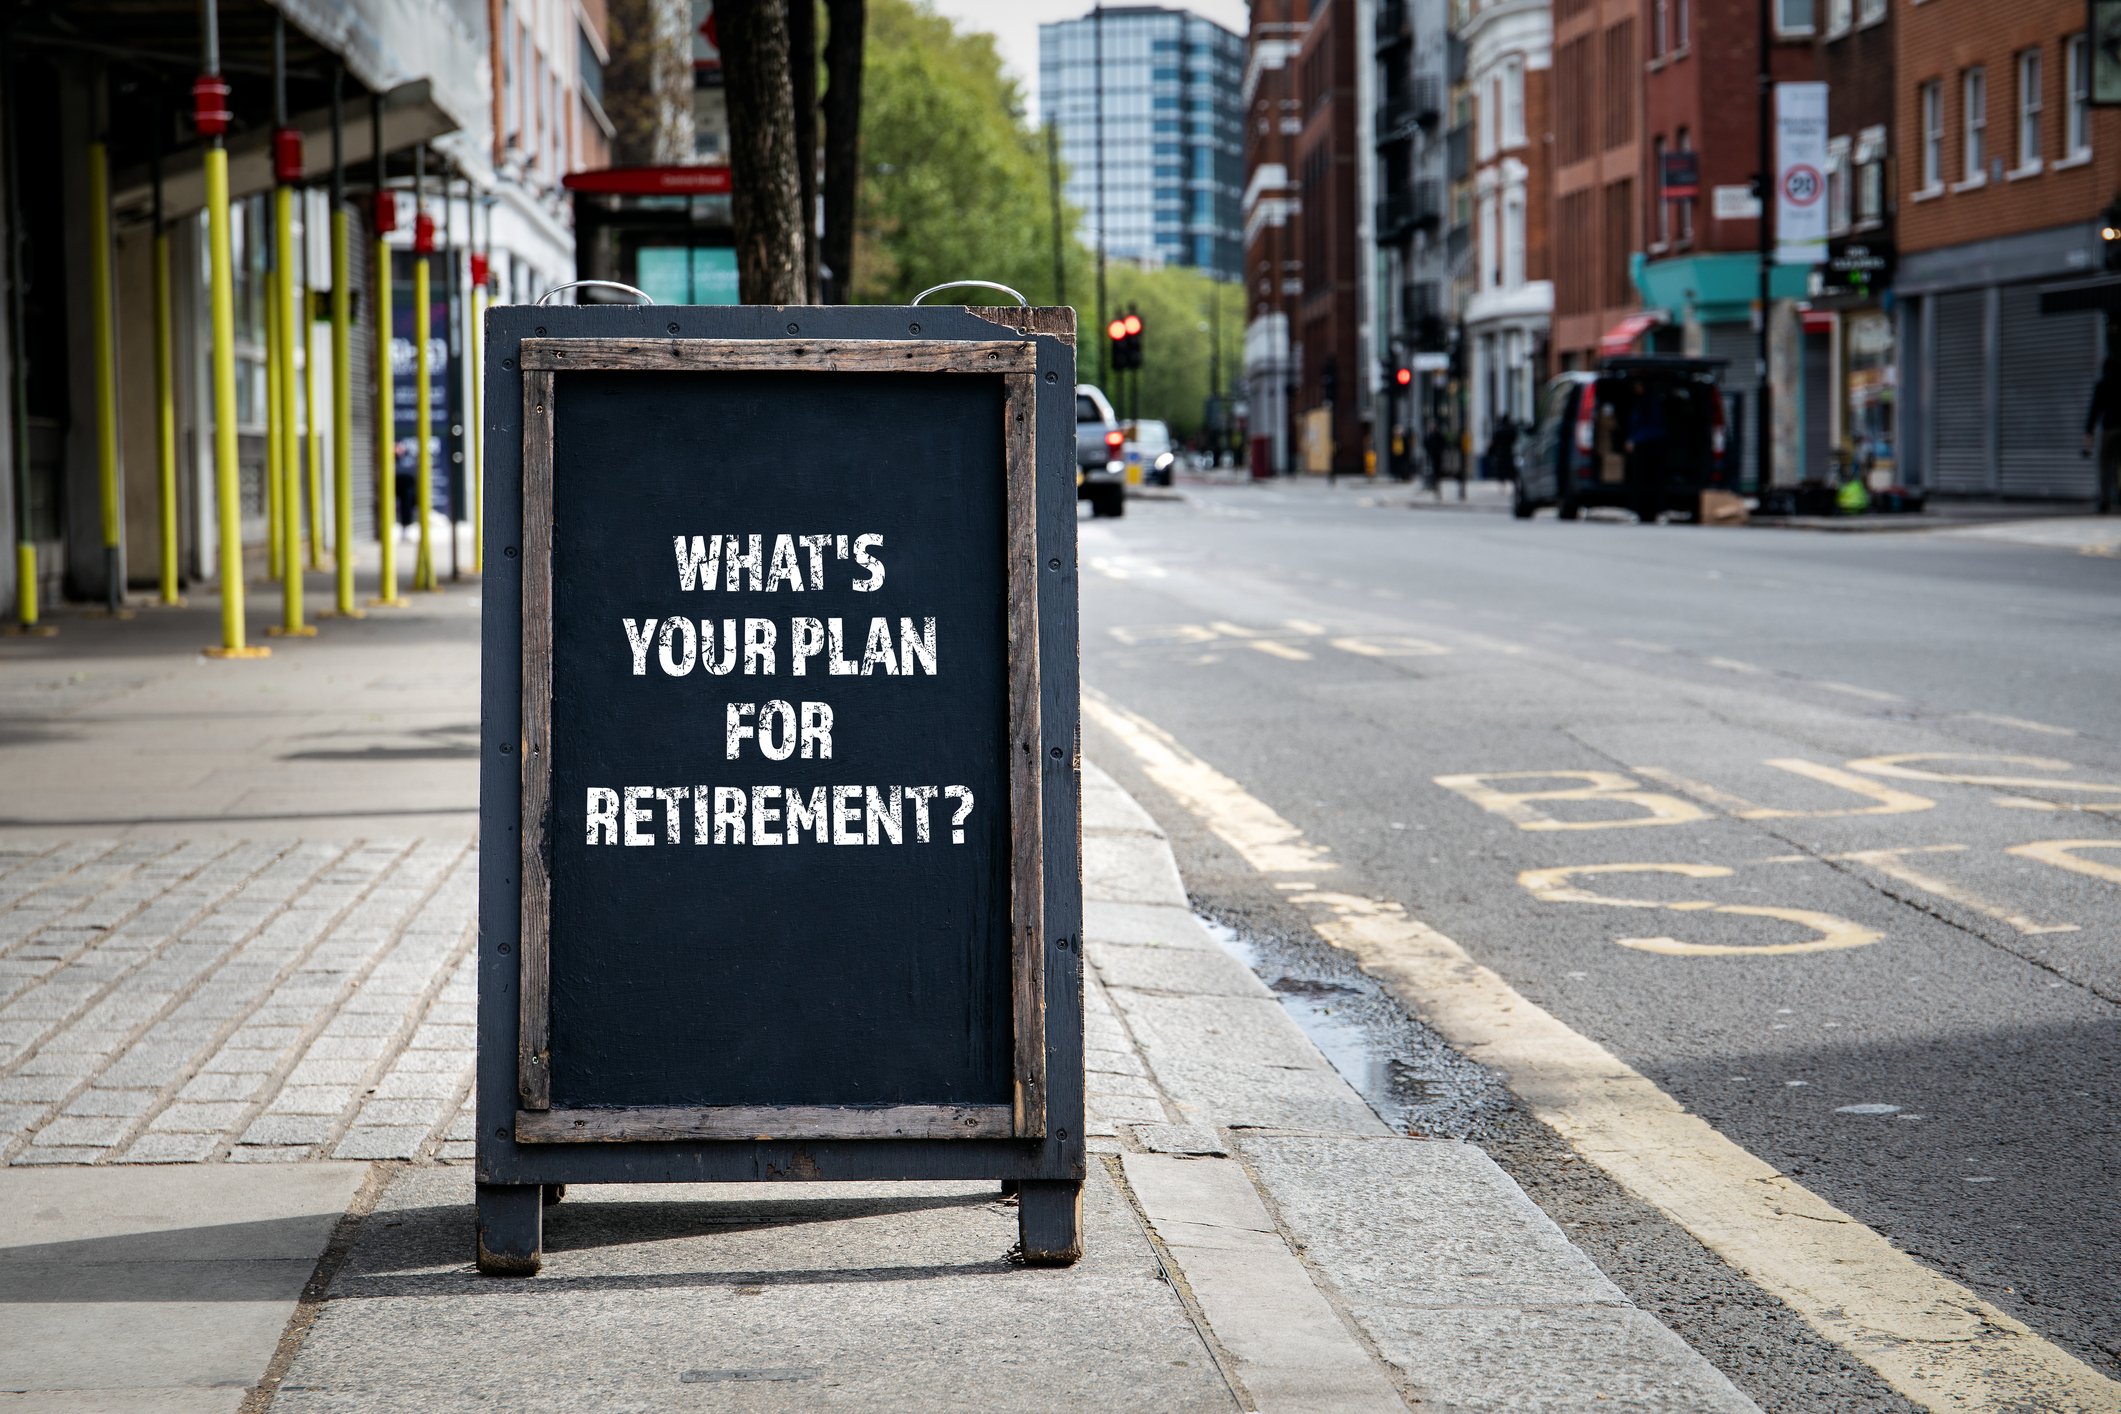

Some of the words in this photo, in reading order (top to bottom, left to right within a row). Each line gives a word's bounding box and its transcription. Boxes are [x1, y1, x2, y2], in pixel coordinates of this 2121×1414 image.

[672, 532, 886, 593] WHAT'S
[622, 615, 778, 677] YOUR
[791, 616, 938, 677] PLAN
[726, 699, 834, 761] FOR
[586, 784, 975, 847] RETIREMENT?
[1432, 752, 2121, 832] BUS
